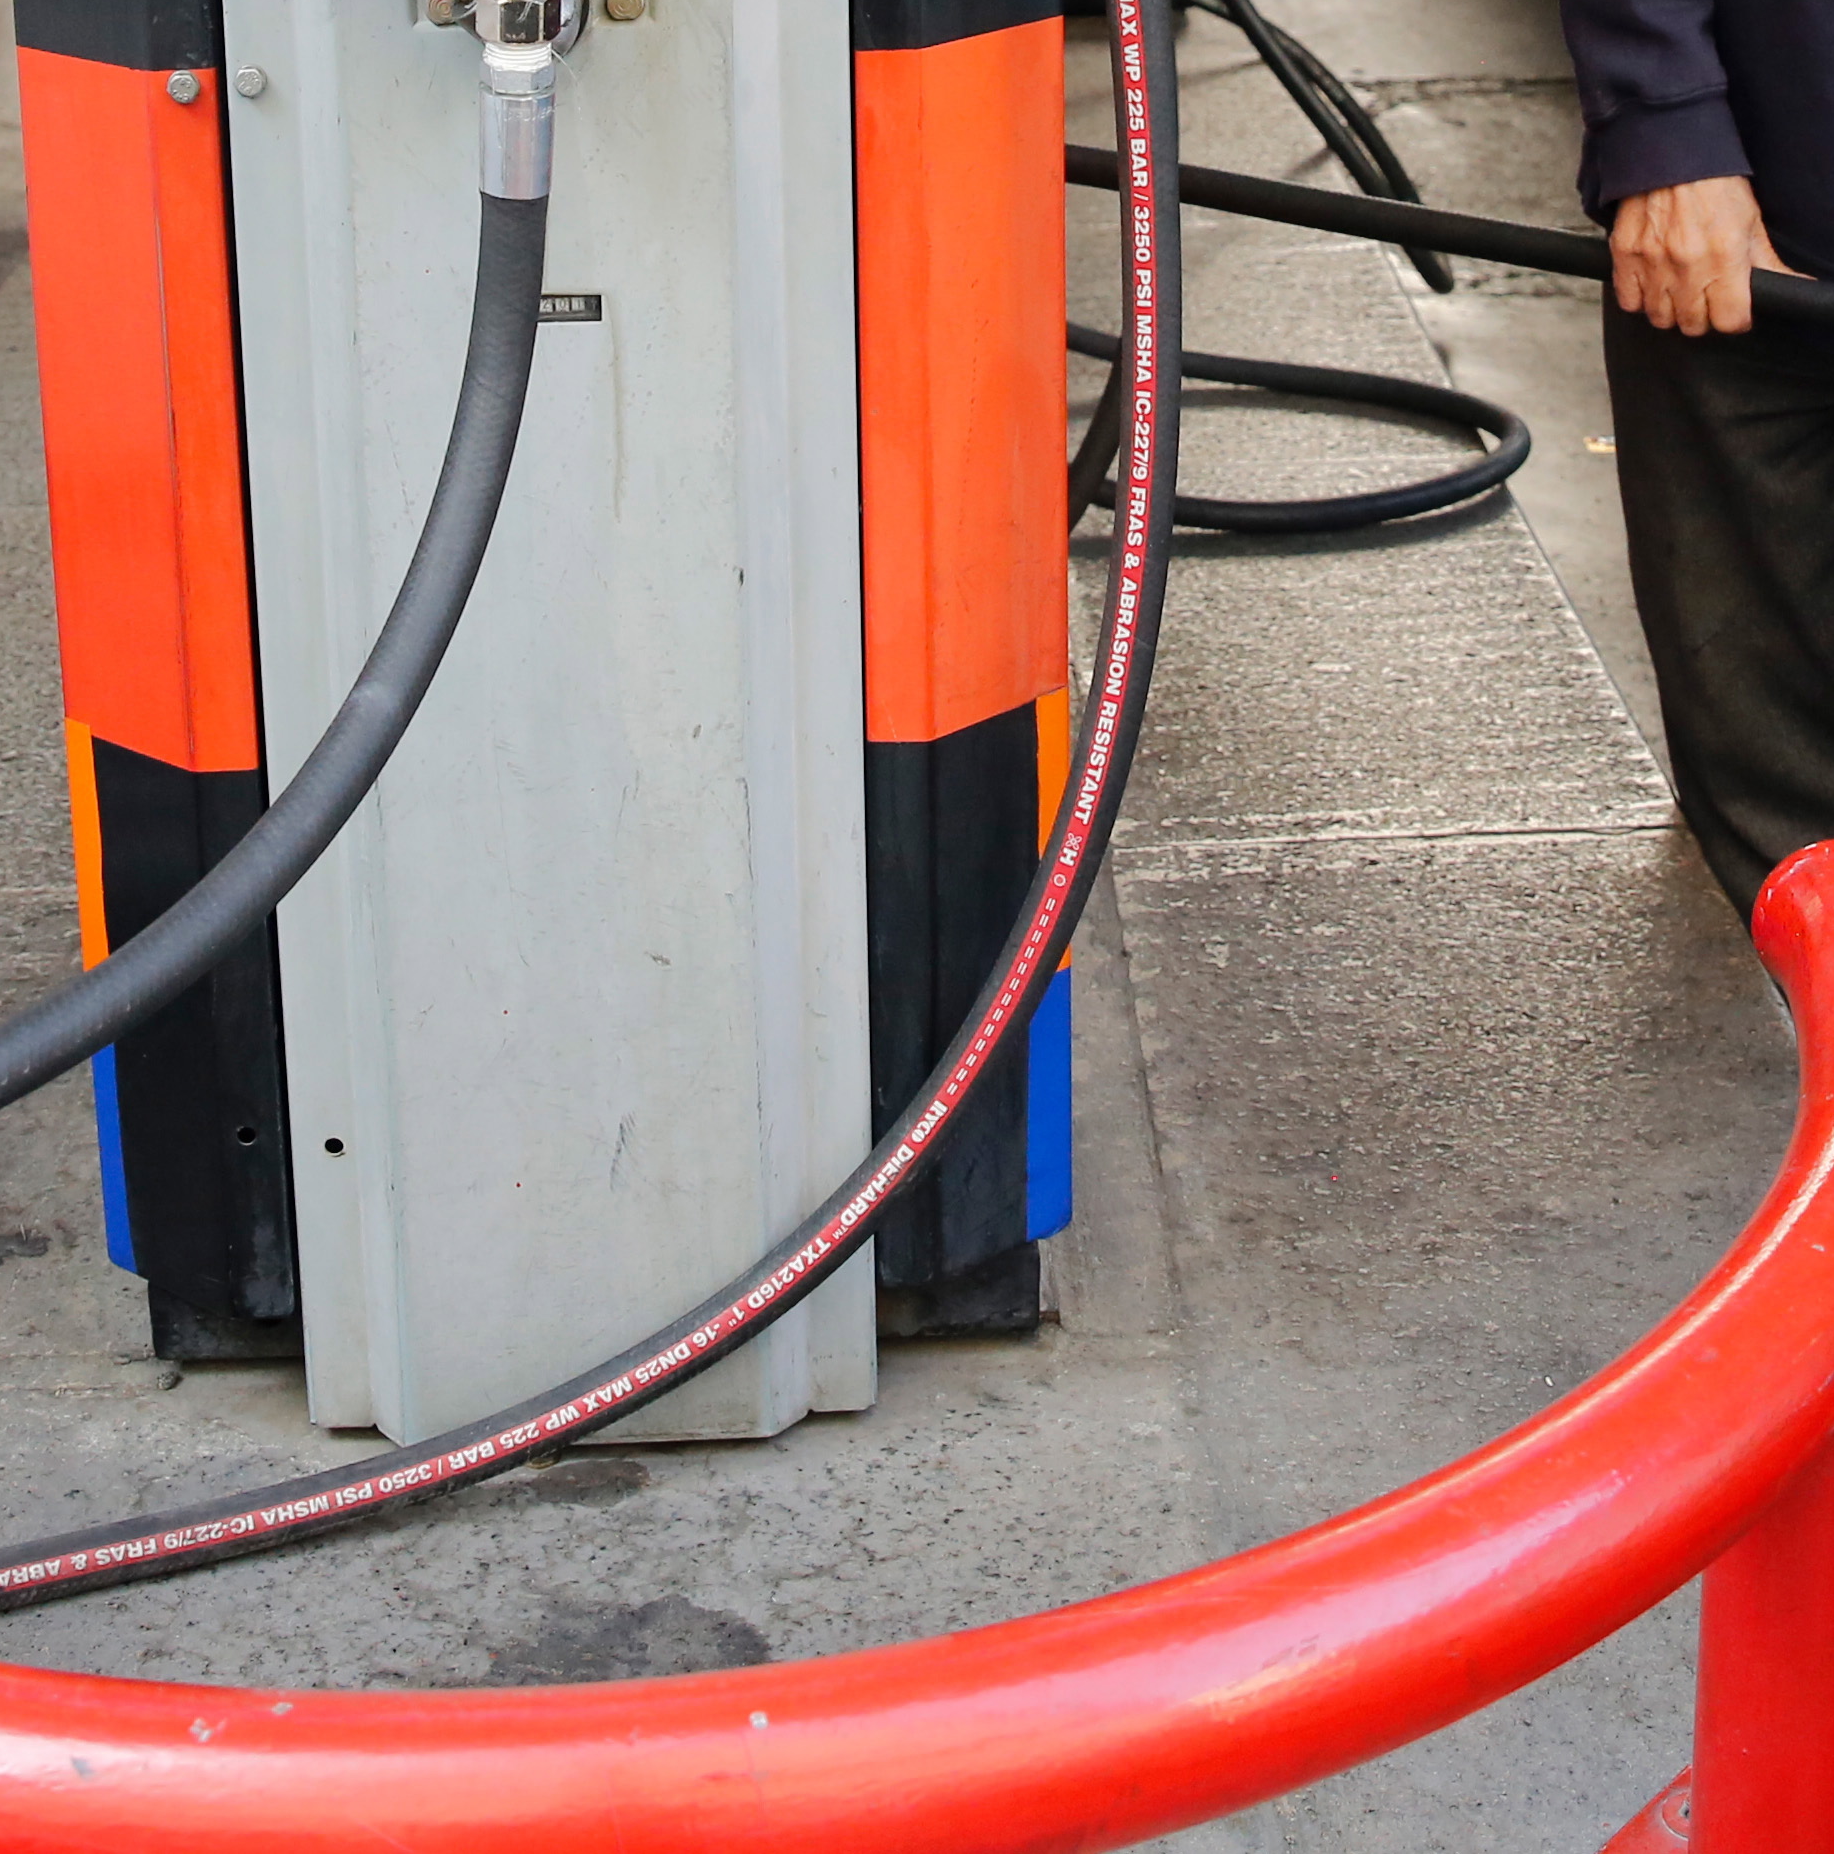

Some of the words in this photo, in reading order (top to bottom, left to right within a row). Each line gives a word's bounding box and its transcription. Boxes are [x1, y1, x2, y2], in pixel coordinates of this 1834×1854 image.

[1122, 43, 1141, 82] WP
[1127, 87, 1145, 131] 225
[1130, 138, 1149, 187] BAR
[1134, 192, 1150, 202] /
[1133, 206, 1151, 262] 3250
[1136, 269, 1152, 307] PSI
[1135, 313, 1152, 383] MSHA
[1132, 390, 1152, 480] IC-227/9
[1123, 485, 1146, 546] FRAS
[1124, 552, 1140, 569] &
[1105, 577, 1138, 696] ABRASION
[1074, 700, 1117, 826] RESISTANT
[910, 1099, 949, 1144] RYCO
[747, 1235, 832, 1312] TXA216D
[637, 1344, 693, 1384] DN25
[584, 1375, 635, 1415] MAX
[499, 1419, 541, 1451] 225
[544, 1403, 581, 1433] WP
[449, 1436, 496, 1472] BAR
[335, 1479, 374, 1508] PSI
[377, 1461, 433, 1495] 3250
[262, 1488, 332, 1526] MSHA
[92, 1535, 158, 1566] FRAS
[163, 1513, 257, 1549] IC-227/9
[69, 1551, 89, 1571] &
